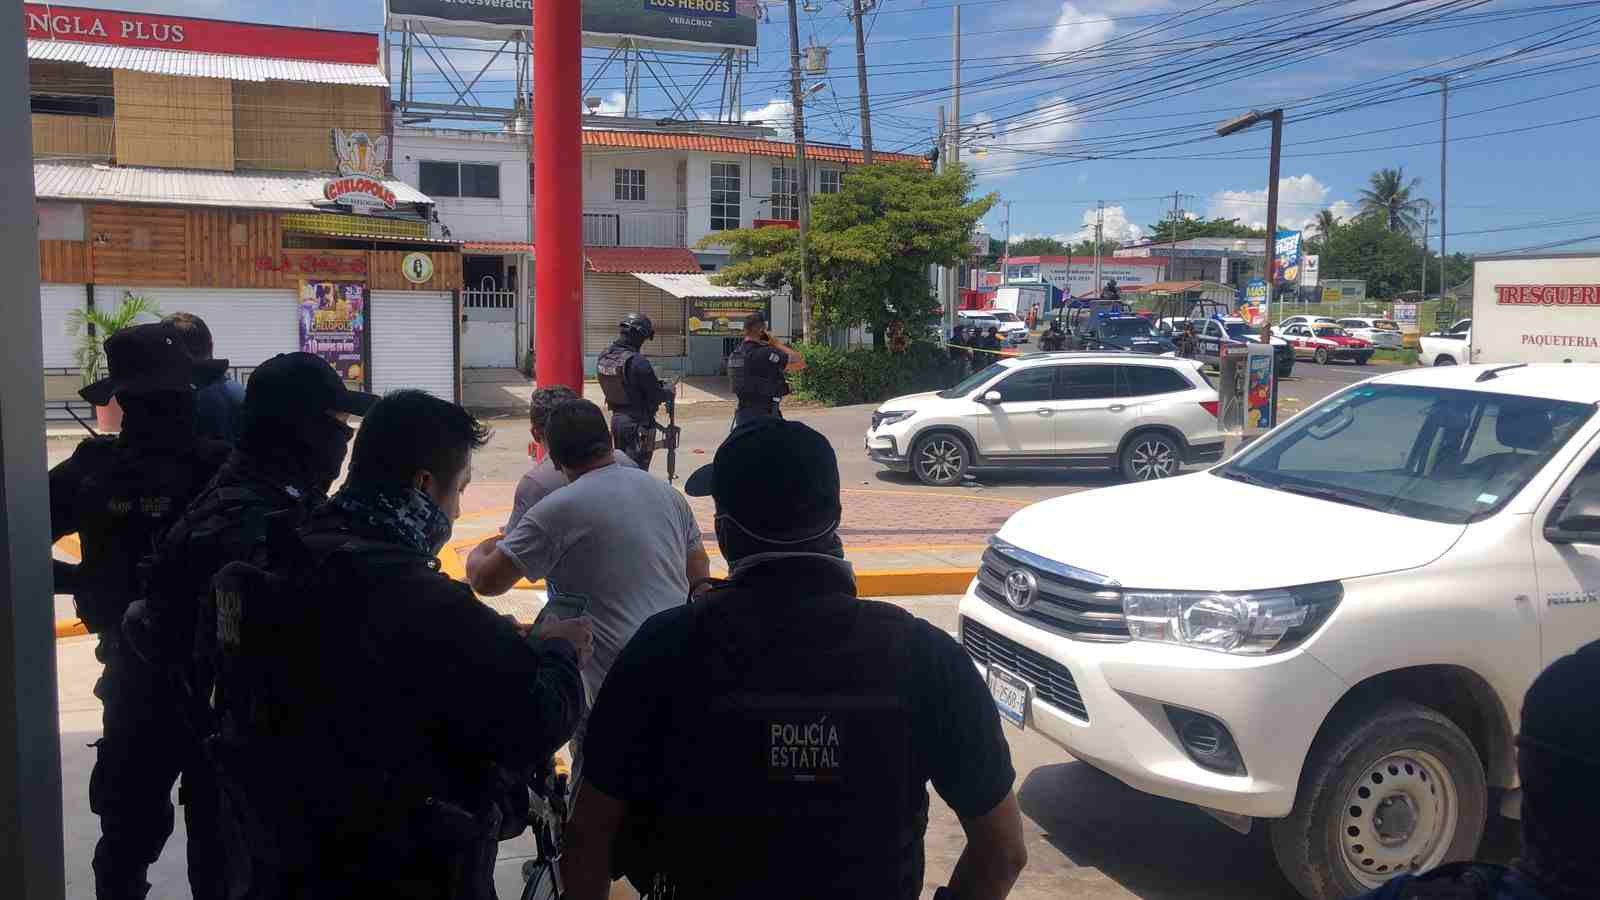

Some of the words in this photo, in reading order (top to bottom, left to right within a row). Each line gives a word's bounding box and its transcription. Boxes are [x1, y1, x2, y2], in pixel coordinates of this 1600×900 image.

[120, 20, 185, 42] PLUS
[668, 16, 713, 27] VERACRUZ
[771, 715, 840, 746] POLICÍA
[771, 747, 840, 768] ESTATAL
